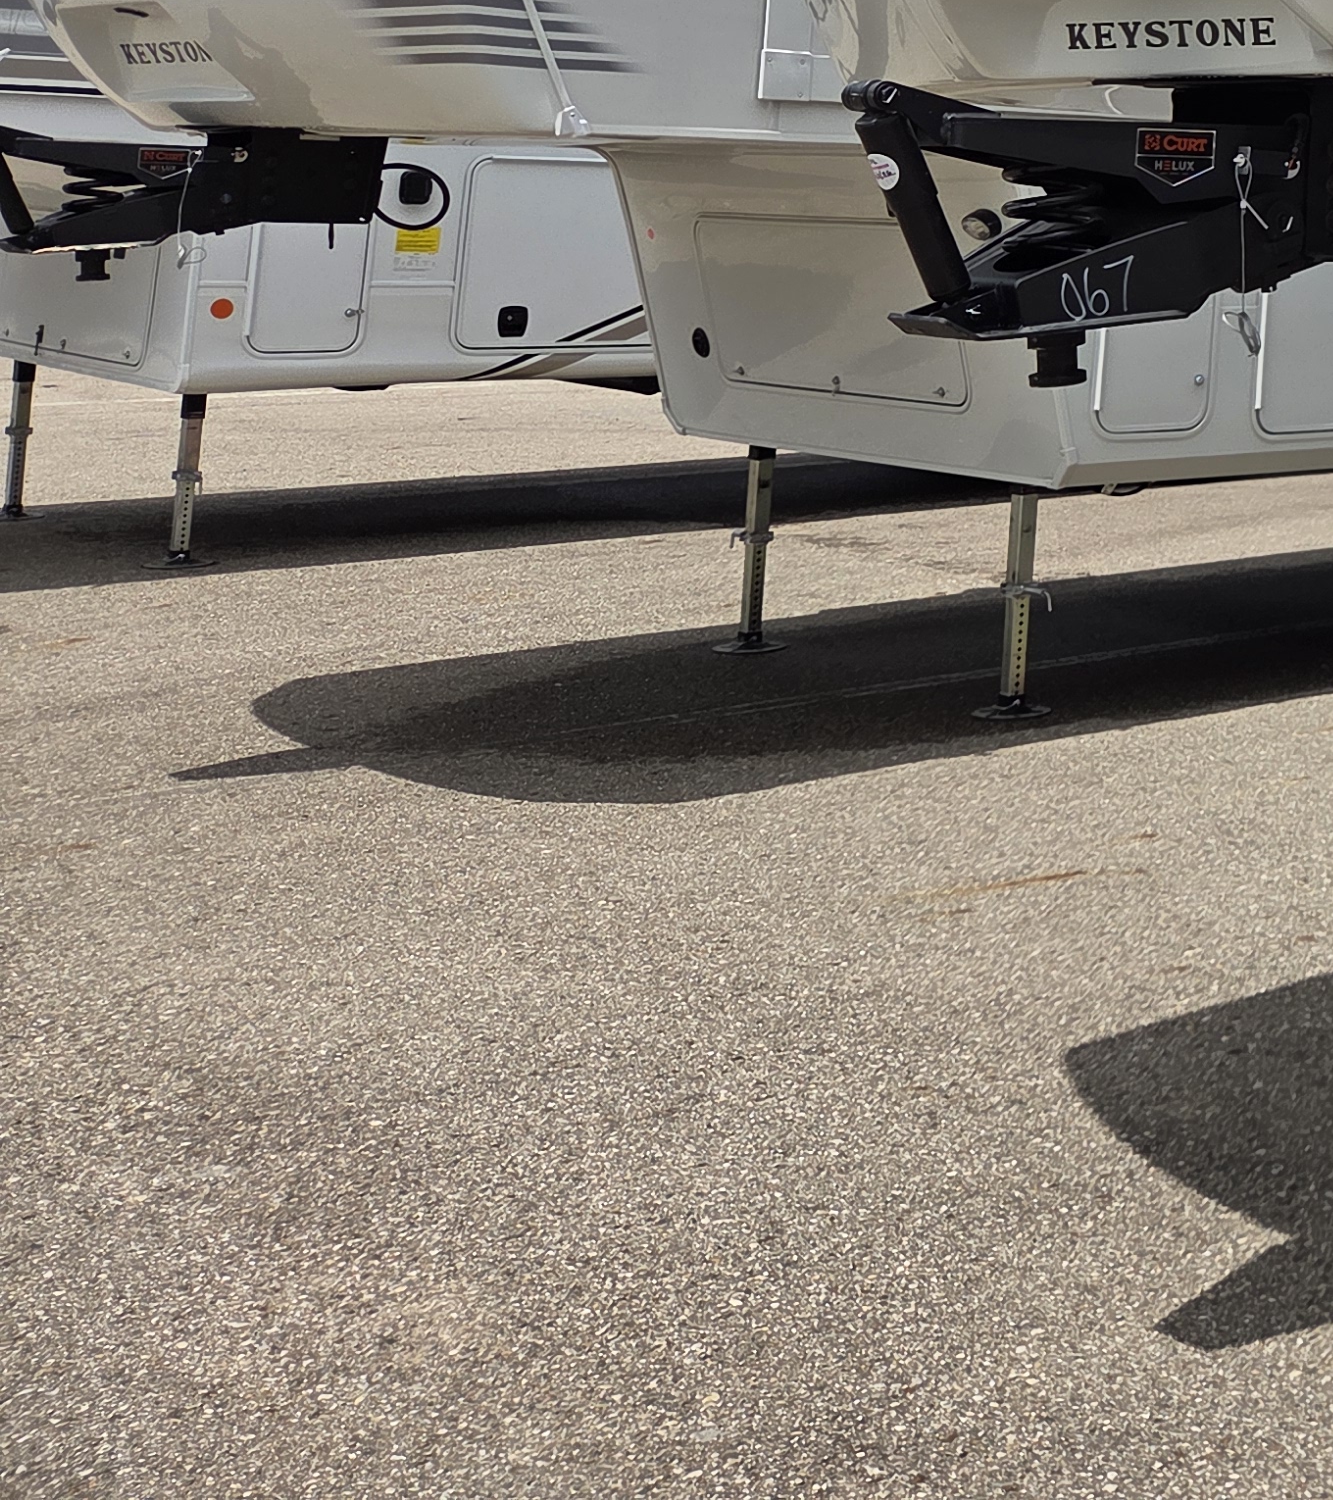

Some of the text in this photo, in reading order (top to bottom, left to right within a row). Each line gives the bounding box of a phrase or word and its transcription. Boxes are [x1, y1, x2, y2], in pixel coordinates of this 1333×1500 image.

[1065, 17, 1277, 50] KEYSTONE
[119, 39, 214, 65] KEYSTON
[1163, 134, 1208, 152] CURT
[1154, 159, 1195, 172] HELUX
[1061, 254, 1135, 322] 067
